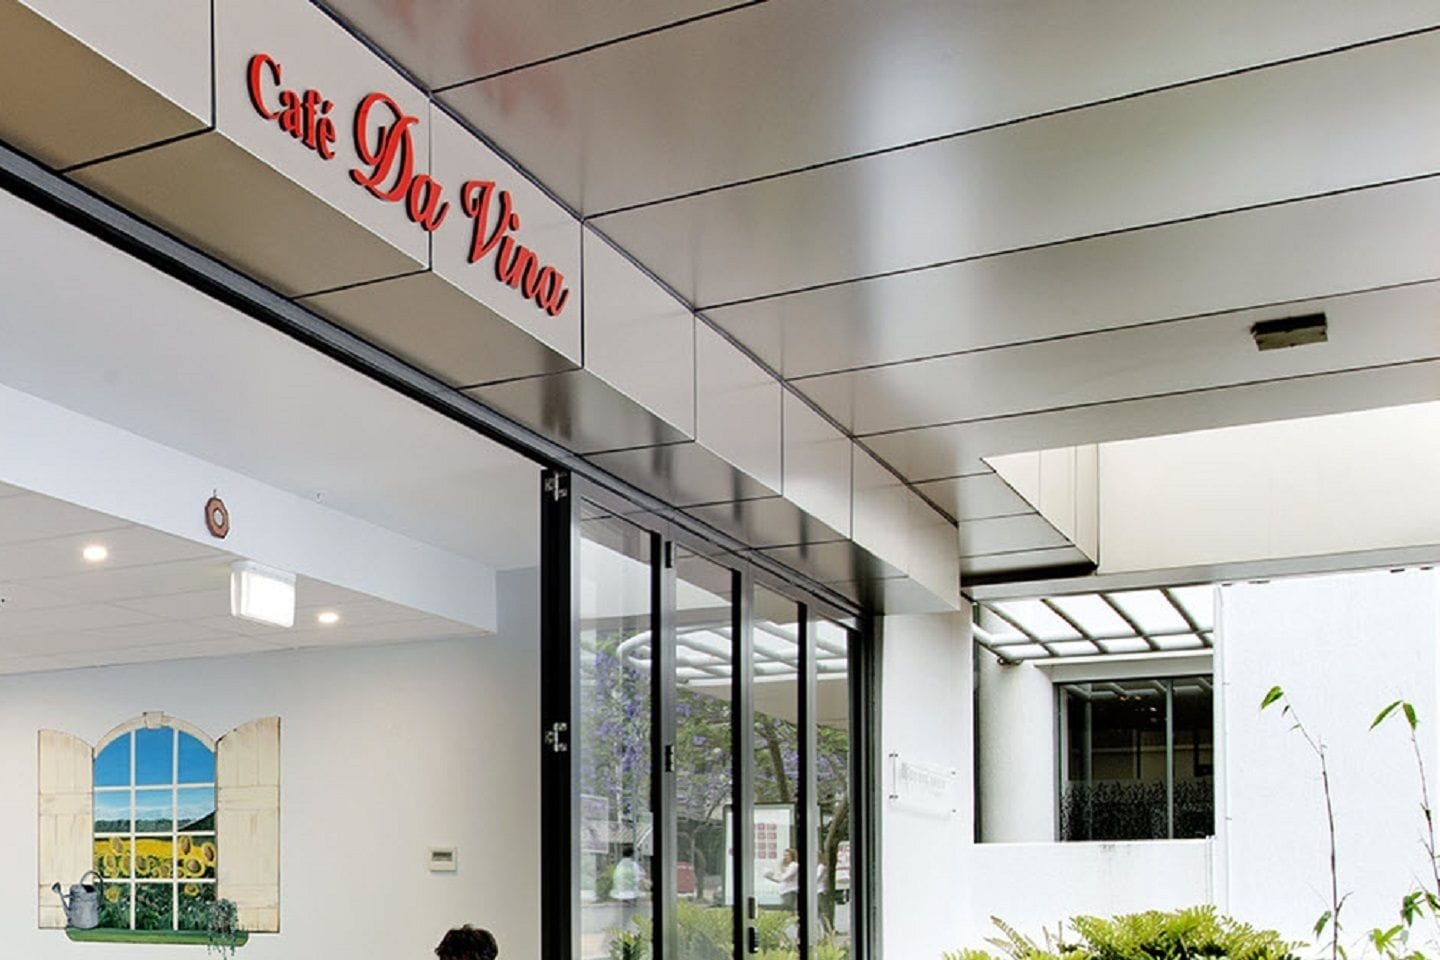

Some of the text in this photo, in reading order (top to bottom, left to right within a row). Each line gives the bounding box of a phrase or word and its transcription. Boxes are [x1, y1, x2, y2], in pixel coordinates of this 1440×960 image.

[247, 53, 569, 317] Café Da Vina
